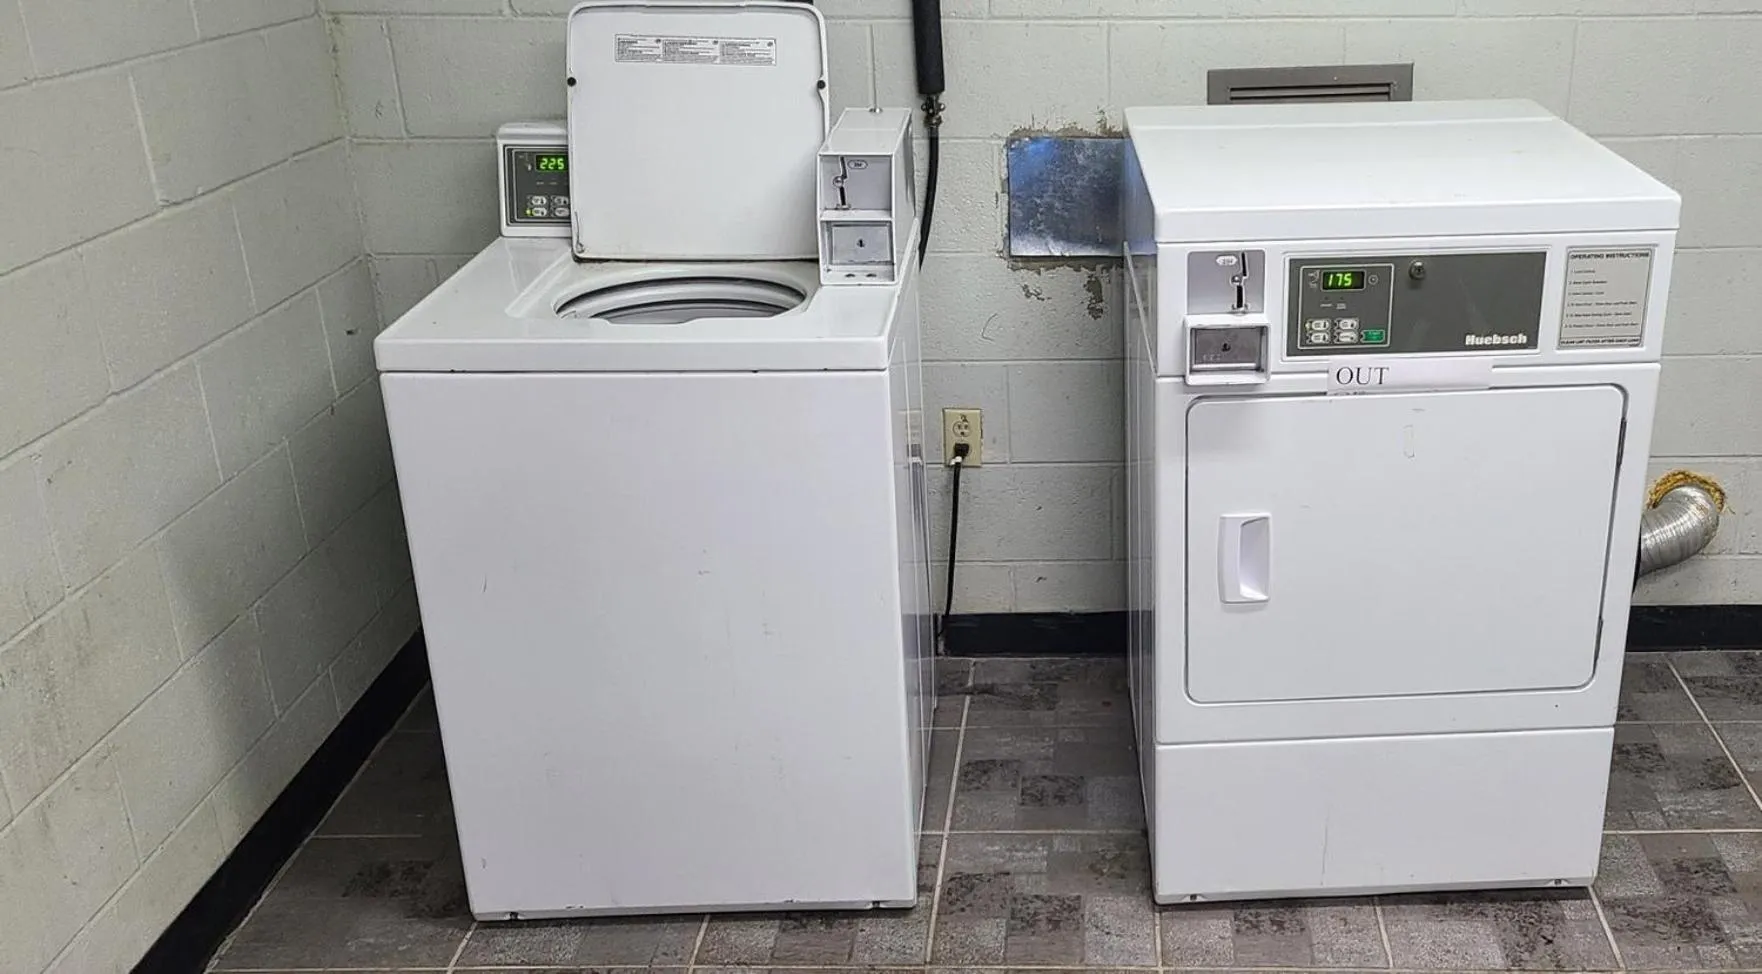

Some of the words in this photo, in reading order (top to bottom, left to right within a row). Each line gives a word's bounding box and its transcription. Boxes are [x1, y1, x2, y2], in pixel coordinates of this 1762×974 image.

[540, 158, 564, 170] 225
[1328, 273, 1352, 287] 175
[1465, 333, 1528, 346] Huebsch
[1336, 366, 1389, 385] OUT
